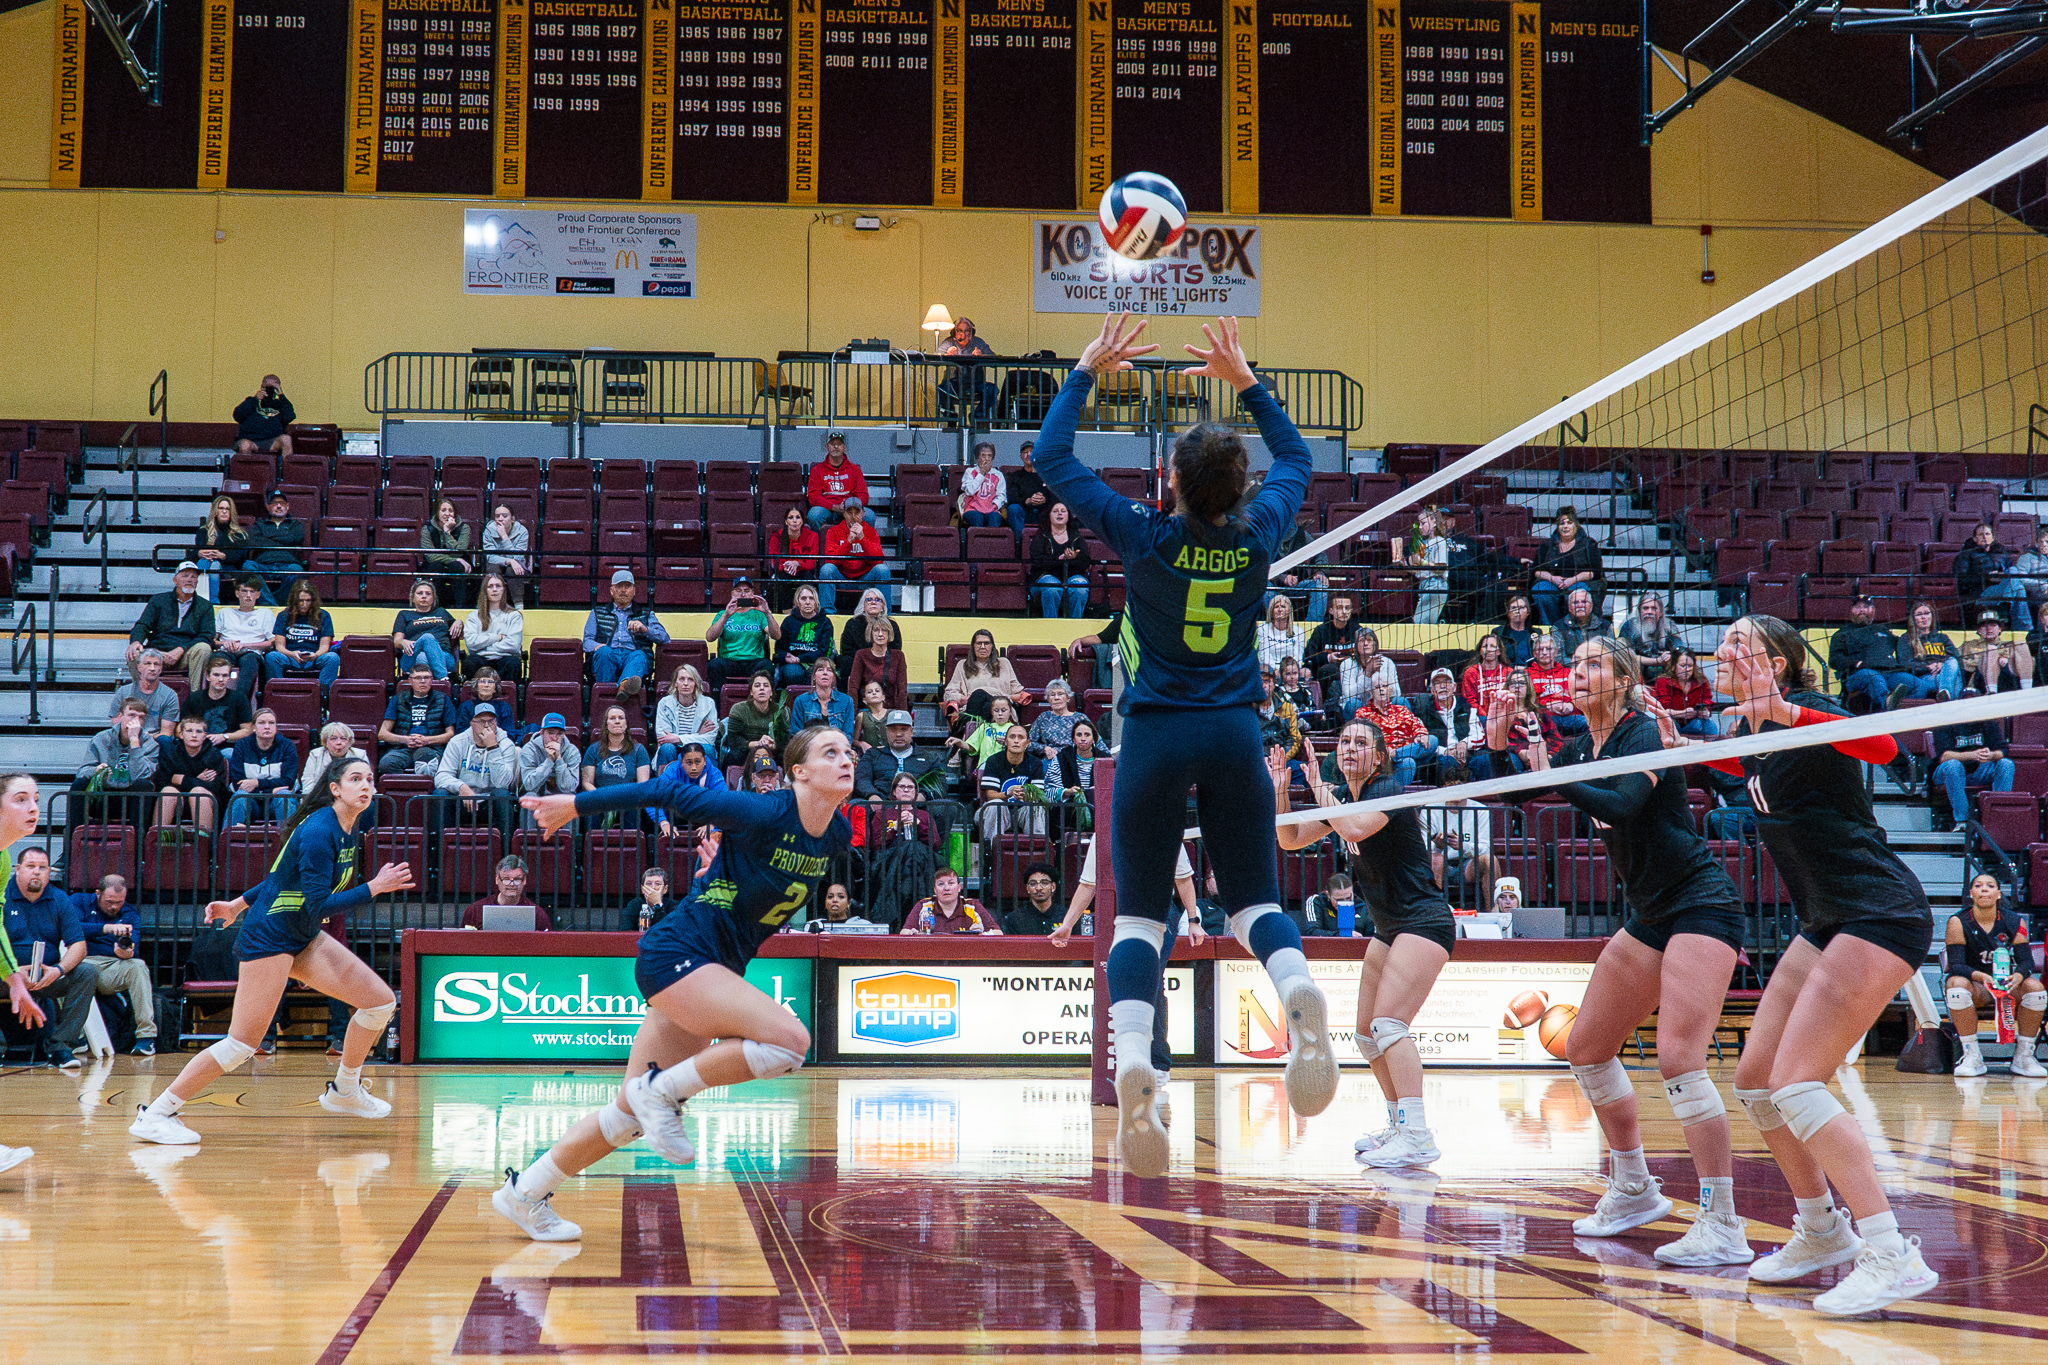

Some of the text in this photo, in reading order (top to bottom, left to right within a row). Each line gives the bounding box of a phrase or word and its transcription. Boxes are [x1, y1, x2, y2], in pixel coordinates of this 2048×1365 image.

[388, 0, 491, 12] BASKETBALL
[534, 2, 637, 17] BASKETBALL
[998, 1, 1044, 11] MEN'S
[1144, 3, 1190, 14] MEN'S
[681, 7, 782, 21] BASKETBALL
[826, 10, 927, 24] BASKETBALL
[1273, 13, 1352, 27] FOOTBALL
[239, 16, 305, 28] 1991 2013
[389, 19, 491, 32] 1990 1991 1992
[971, 15, 1071, 29] BASKETBALL
[1118, 18, 1217, 32] BASKETBALL
[1410, 17, 1500, 31] WRESTLING
[535, 24, 636, 38] 1985 1986 1987
[681, 27, 782, 40] 1985 1986 1987
[1550, 22, 1639, 37] MEN'S GOLF
[826, 31, 927, 45] 1995 1996 1998
[970, 35, 1070, 49] 1995 2011 2012
[506, 14, 522, 78] CHAMPIONS
[1117, 39, 1216, 53] 1995 1996 1998
[1263, 43, 1290, 54] 2006
[1406, 47, 1503, 60] 1988 1990 1991
[1546, 52, 1573, 62] 1991
[862, 56, 890, 68] 2011
[899, 57, 927, 69] 2012
[1117, 63, 1216, 77] 2009 2011 2012
[59, 4, 79, 172] NAIA TOURNAMENT
[206, 4, 226, 175] CONFERENCE CHAMPIONS
[355, 10, 375, 175] NAIA TOURNAMENT
[1117, 87, 1180, 99] 2013 2014
[386, 93, 489, 106] 1999 2001 2006
[651, 19, 668, 187] CONFERENCE CHAMPIONS
[1237, 33, 1252, 161] NAIA PLAYOFFS
[1407, 94, 1504, 108] 2000 2001 2002
[534, 98, 599, 111] 1998 1999
[796, 22, 814, 191] CONFERENCE CHAMPIONS
[942, 26, 958, 194] CONF. TOURNAMENT CHAMPIONS
[504, 79, 521, 153] TOURNAMENT
[1090, 30, 1105, 194] NAIA TOURNAMENT
[1380, 33, 1394, 205] NAIA REGIONAL CHAMPIONS
[385, 117, 488, 130] 2014 2015 2016
[680, 124, 780, 137] 1997 1998 1999
[1407, 118, 1504, 132] 2003 2004 2005
[1520, 41, 1535, 208] CONFERENCE CHAMPIONS
[384, 141, 414, 153] 2017
[1407, 142, 1434, 154] 2016
[504, 158, 519, 185] CONF.
[558, 213, 682, 227] Proud Corporate Sponsors
[558, 226, 681, 236] of the Frontier Conference
[468, 271, 549, 283] FRONTIER
[1051, 272, 1066, 282] 610
[661, 286, 686, 294] pepsi
[1065, 285, 1107, 299] VOICE
[1115, 287, 1132, 299] OF
[1140, 287, 1167, 301] THE
[1109, 302, 1186, 313] SINCE 1947
[1174, 545, 1249, 573] ARGOS
[1183, 578, 1235, 654] 5
[760, 882, 808, 925] 2
[858, 989, 950, 1008] town
[1060, 1004, 1094, 1018] AN
[861, 1010, 951, 1029] pump
